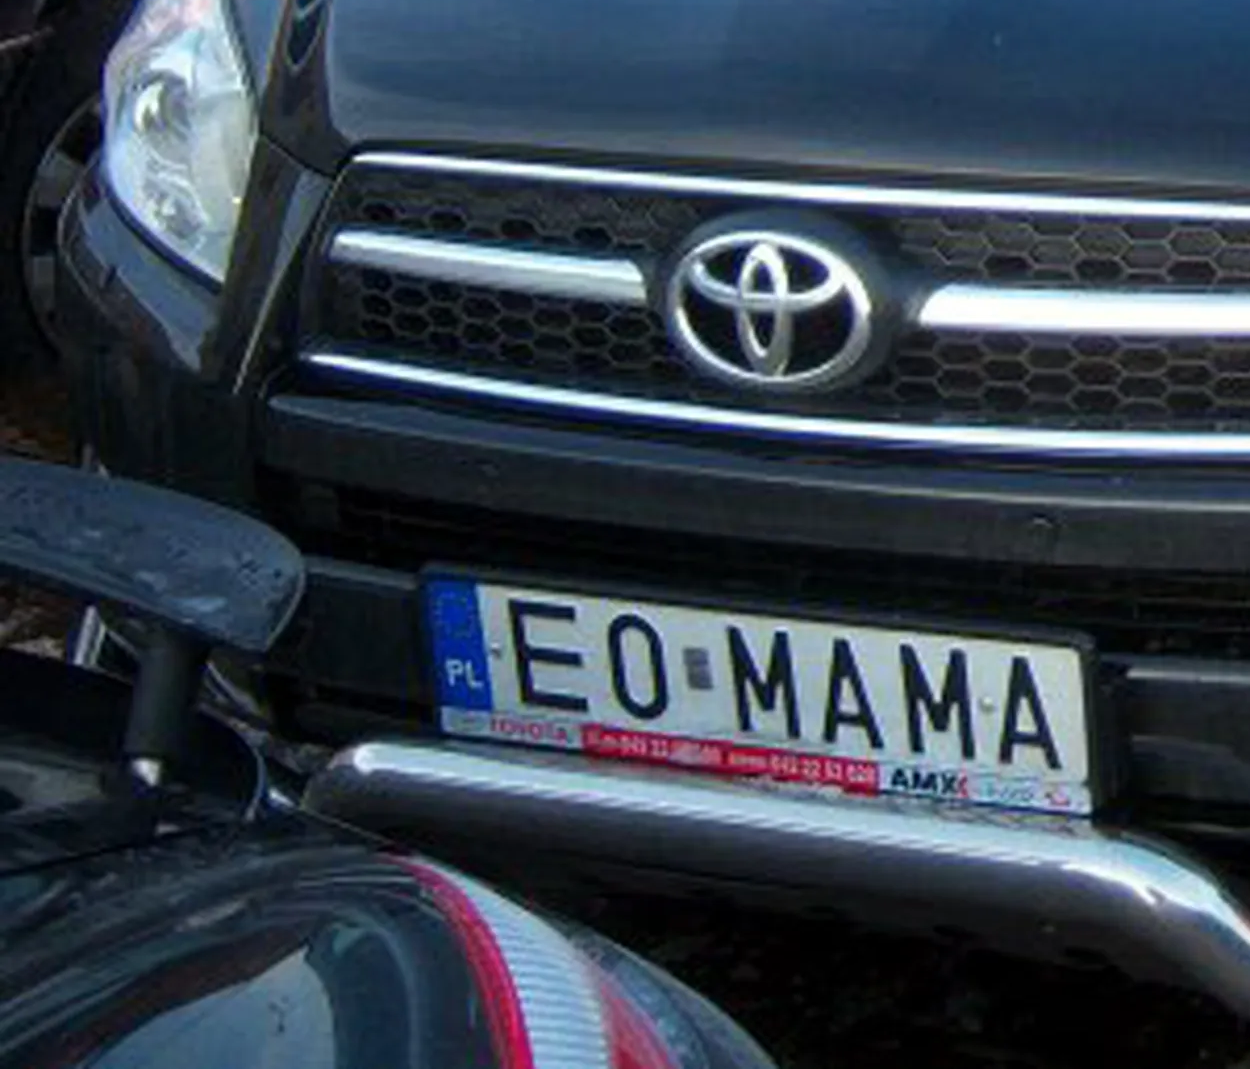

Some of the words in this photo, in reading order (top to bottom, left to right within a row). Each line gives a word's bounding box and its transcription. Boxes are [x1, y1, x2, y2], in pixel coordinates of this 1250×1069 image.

[445, 658, 484, 689] PL
[507, 598, 669, 720] EO
[726, 625, 1062, 770] MAMA
